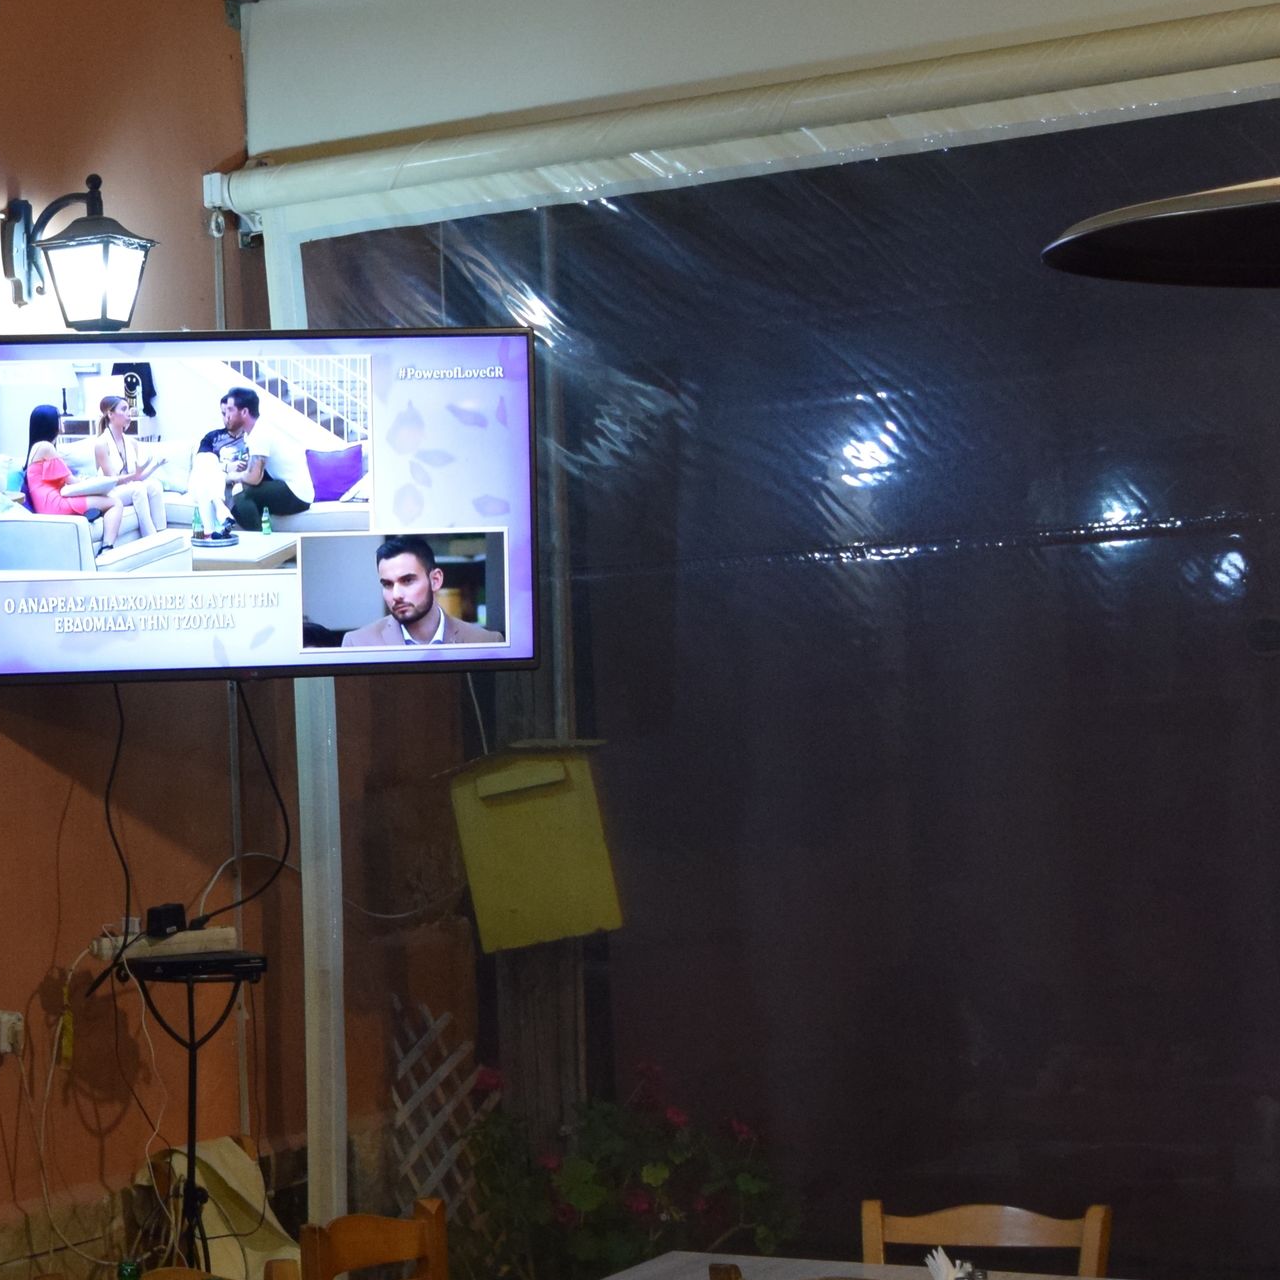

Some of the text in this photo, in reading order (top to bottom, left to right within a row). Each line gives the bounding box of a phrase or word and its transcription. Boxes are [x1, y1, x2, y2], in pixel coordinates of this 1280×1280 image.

[399, 366, 504, 380] #PowerofLoveGR
[3, 591, 280, 615] Ο ΑΝΔΡΕΑΣ ΑΠΑΣΧΟΛΗΣΕ ΚΙ ΑΥΤΗ ΤΗΝ
[54, 613, 236, 634] ΕΒΔΟΜΑΔΑ ΤΗΝ ΤΖΟΥΛΙΑ
